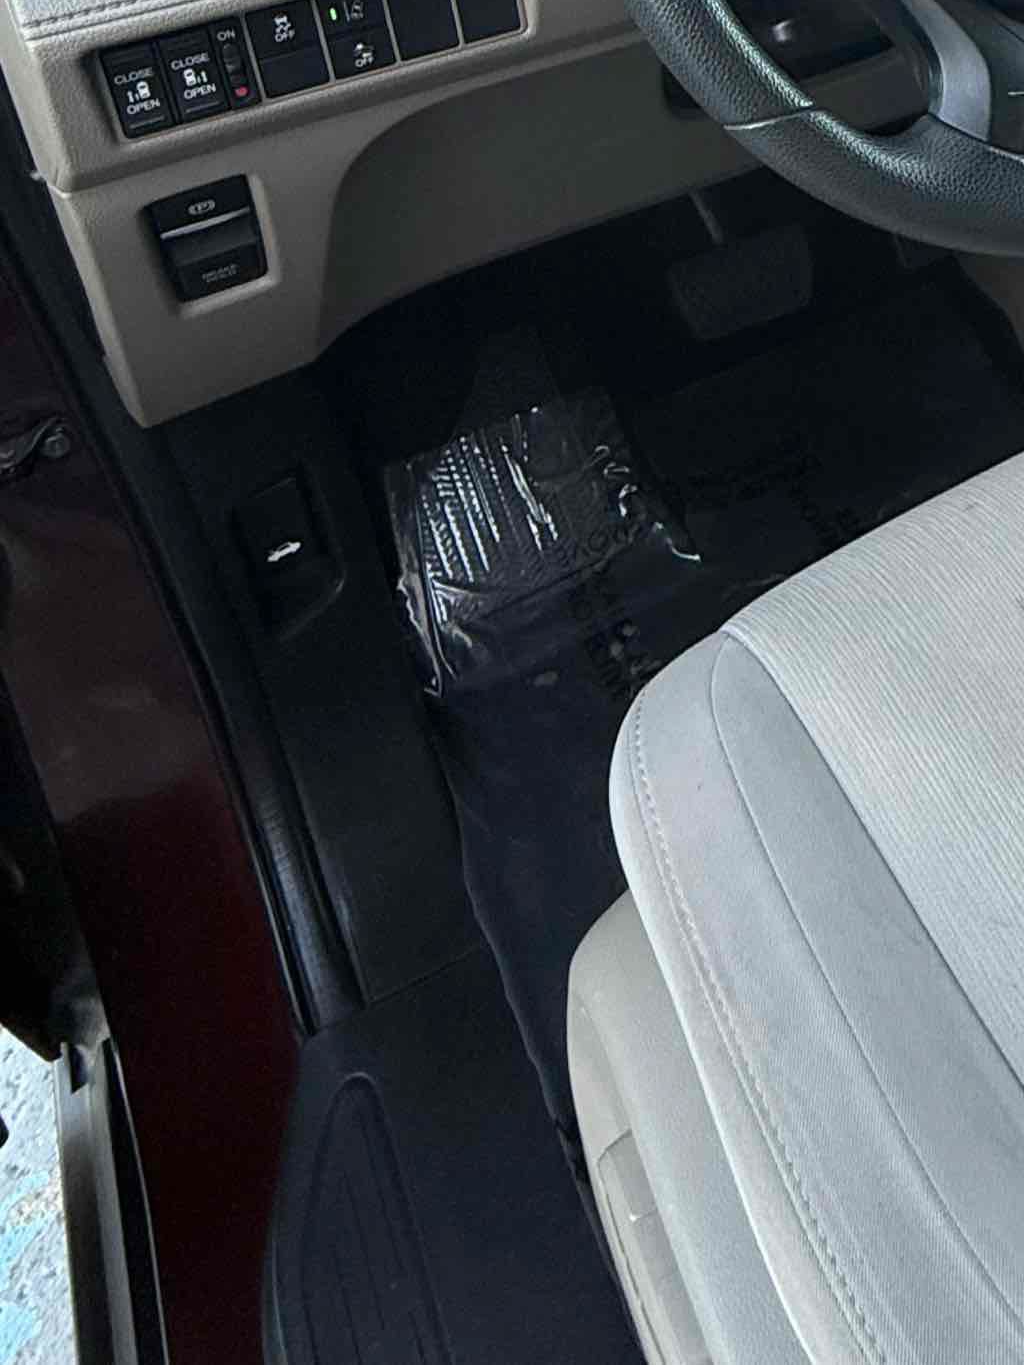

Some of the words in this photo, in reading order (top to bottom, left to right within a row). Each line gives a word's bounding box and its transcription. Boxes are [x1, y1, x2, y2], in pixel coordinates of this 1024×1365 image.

[216, 28, 236, 42] ON
[275, 29, 295, 43] OFF
[170, 52, 210, 71] CLOSE
[355, 55, 375, 69] OFF
[114, 67, 153, 85] CLOSE
[183, 84, 217, 101] OPEN
[126, 97, 161, 115] OPEN
